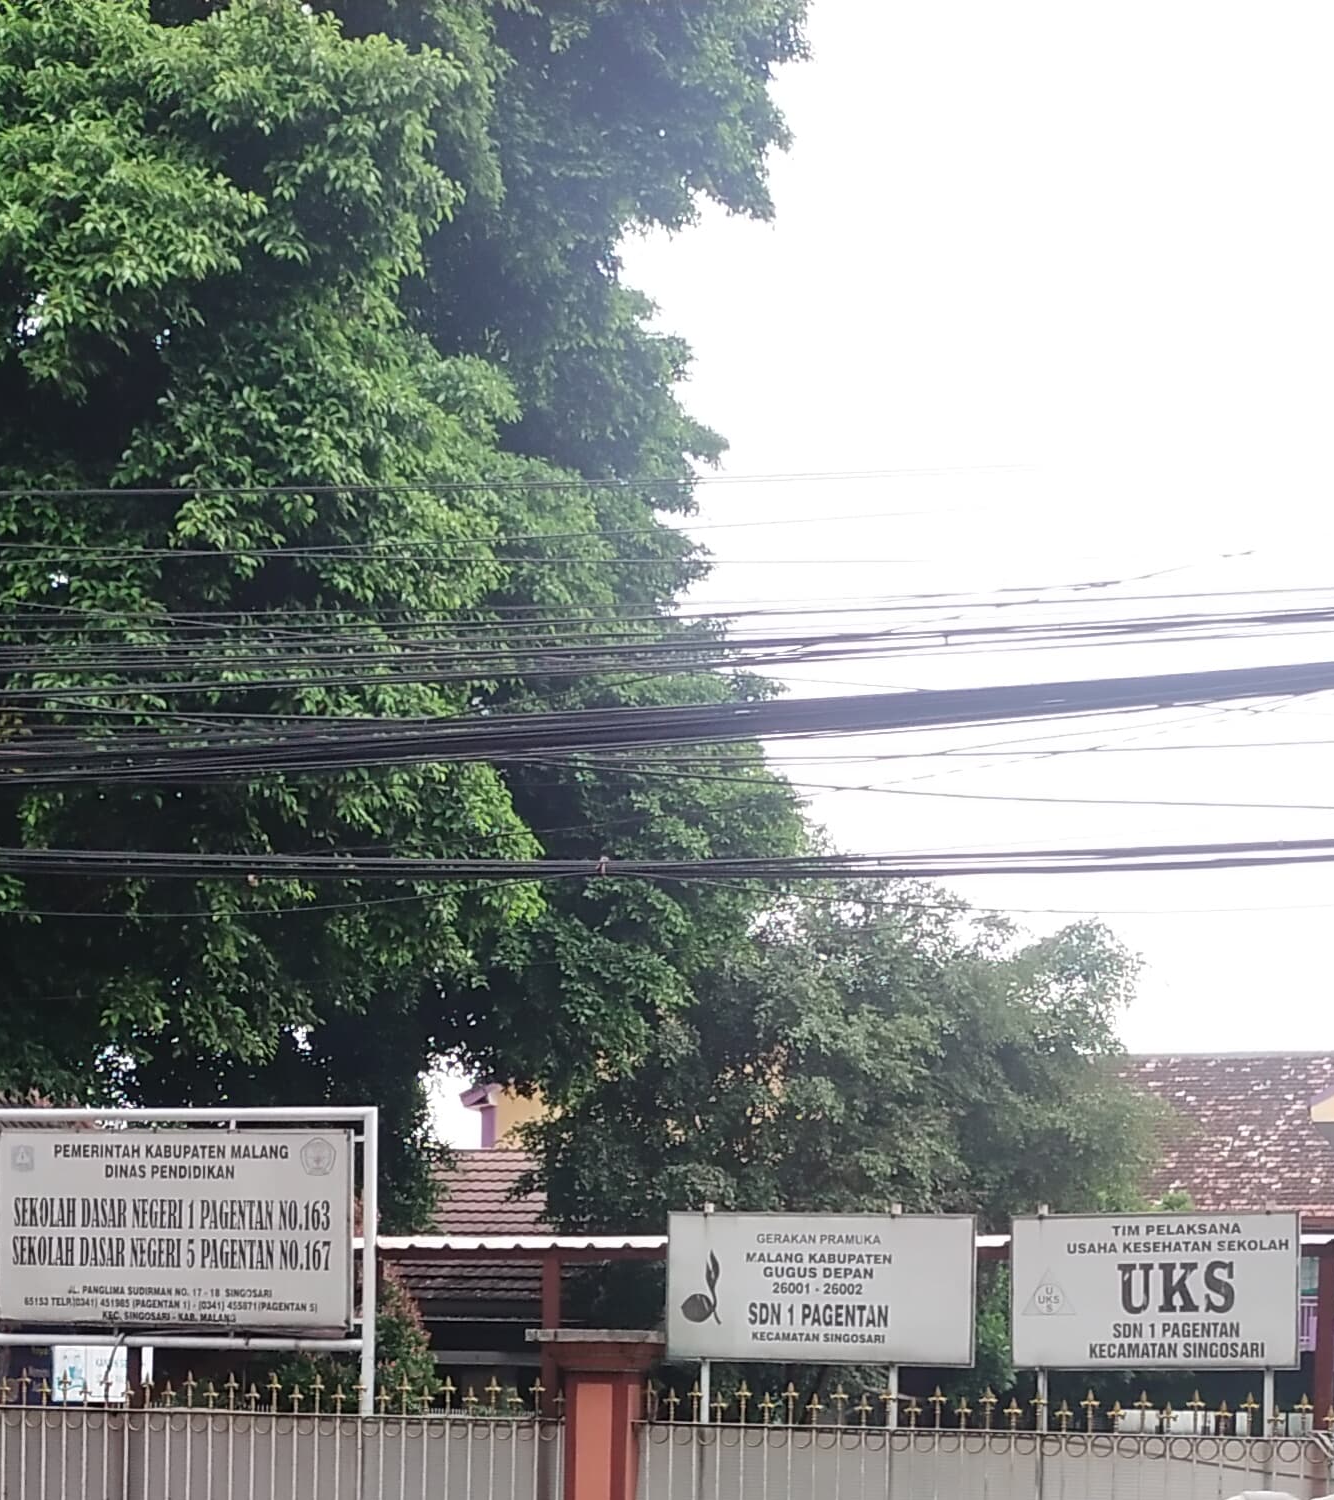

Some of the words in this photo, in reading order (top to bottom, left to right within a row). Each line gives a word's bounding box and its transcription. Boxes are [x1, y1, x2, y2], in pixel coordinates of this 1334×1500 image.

[54, 1145, 140, 1159] PEMERINTAH
[145, 1145, 226, 1159] KABUPATEN
[231, 1145, 289, 1160] MALANG
[104, 1165, 146, 1179] DINAS
[151, 1165, 235, 1180] PENDIDIKAN
[14, 1197, 77, 1228] SEKOLAH
[81, 1198, 127, 1229] DASAR
[131, 1199, 183, 1230] NEGERI
[188, 1200, 195, 1230] 1
[200, 1200, 274, 1231] PAGENTAN
[278, 1200, 331, 1231] NO.163
[1112, 1225, 1140, 1236] TIM
[1145, 1223, 1242, 1236] PELAKSANA
[756, 1233, 816, 1244] GERAKAN
[819, 1234, 881, 1245] PRAMUKA
[12, 1236, 75, 1266] SEKOLAH
[79, 1237, 125, 1267] DASAR
[130, 1238, 182, 1268] NEGERI
[187, 1239, 195, 1269] 5
[200, 1239, 275, 1270] PAGENTAN
[278, 1240, 331, 1271] NO.167
[1067, 1242, 1117, 1254] USAHA
[1123, 1240, 1212, 1253] KESEHATAN
[1217, 1239, 1289, 1252] SEKOLAH
[746, 1252, 803, 1263] MALANG
[808, 1253, 892, 1264] KABUPATEN
[763, 1266, 817, 1278] GUGUS
[823, 1268, 874, 1279] DEPAN
[82, 1286, 125, 1295] PANGLIMA
[127, 1286, 172, 1296] SUDIRMAN
[192, 1288, 202, 1297] 17
[225, 1288, 273, 1298] SINGOSARI
[772, 1282, 810, 1294] 26001
[823, 1283, 863, 1295] 26002
[1117, 1260, 1235, 1314] UKS
[1038, 1295, 1060, 1304] UKS
[124, 1311, 170, 1322] SINGOSARI
[748, 1302, 781, 1325] SDN
[788, 1304, 794, 1326] 1
[802, 1304, 889, 1328] PAGENTAN
[752, 1331, 820, 1342] KECAMATAN
[823, 1332, 885, 1343] SINGOSARI
[1113, 1322, 1143, 1338] SDN
[1149, 1323, 1155, 1338] 1
[1162, 1322, 1240, 1338] PAGENTAN
[1089, 1343, 1177, 1359] KECAMATAN
[1182, 1342, 1265, 1358] SINGOSARI
